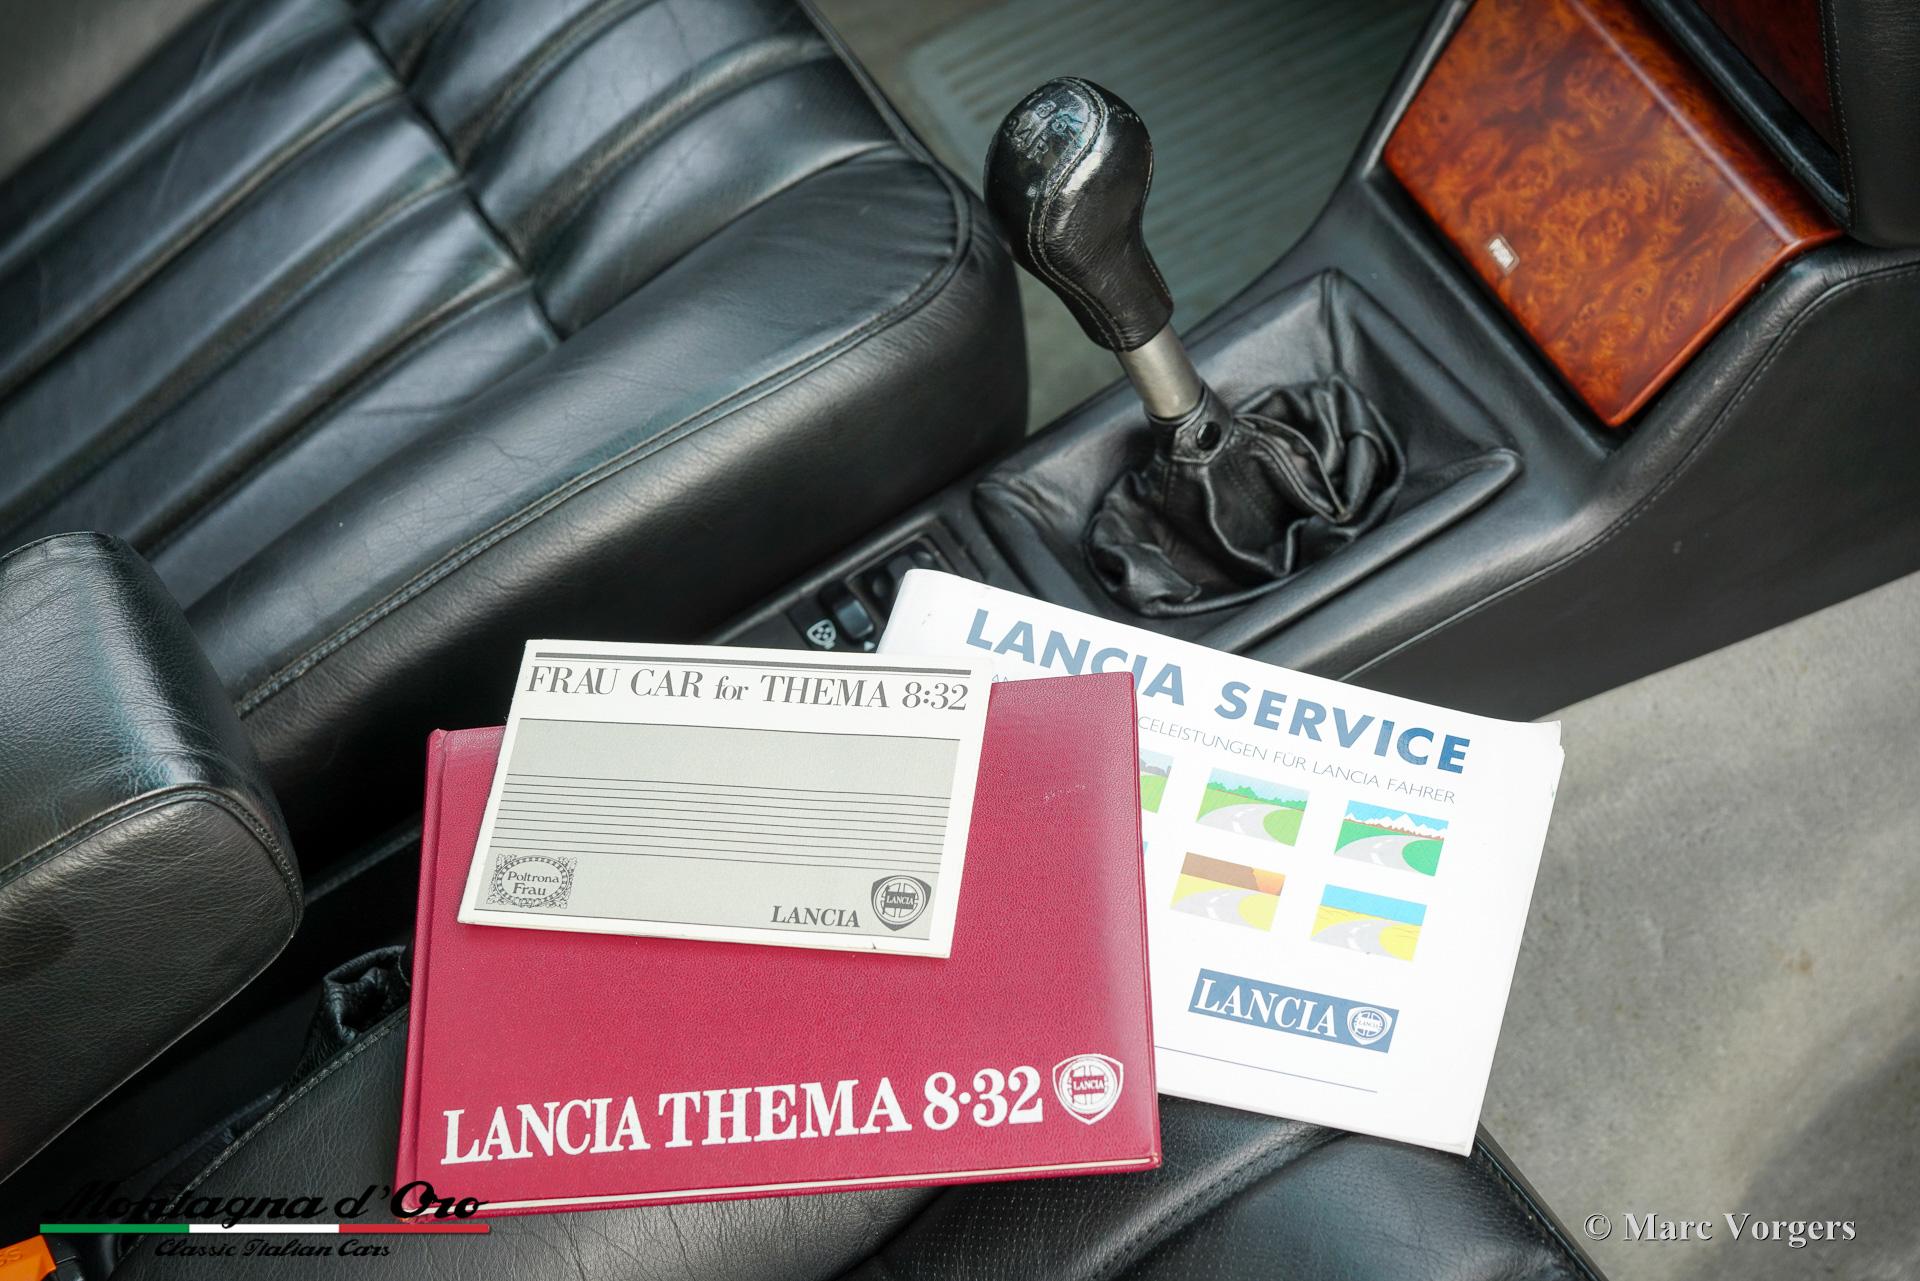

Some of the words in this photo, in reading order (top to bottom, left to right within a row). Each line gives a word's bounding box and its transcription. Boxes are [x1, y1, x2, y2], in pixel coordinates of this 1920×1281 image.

[526, 666, 618, 695] FRAU
[630, 669, 703, 698] CAR
[714, 676, 748, 700] for
[760, 674, 890, 708] THEMA
[902, 681, 968, 712] 8:32
[966, 608, 1184, 706] LANCIA
[1214, 680, 1471, 774] SERVICE
[1138, 715, 1267, 760] CELEISTUNGEN
[1273, 750, 1306, 770] FÜR
[1313, 761, 1380, 788] LANCIA
[1387, 778, 1455, 804] FAHRER
[507, 871, 559, 883] Poltrona
[512, 882, 547, 896] Frau
[770, 905, 861, 928] LANCIA
[886, 895, 914, 905] LANCIA
[1194, 978, 1338, 1038] LANCIA
[1073, 1078, 1104, 1092] LANCIA
[440, 1095, 651, 1165] LANCIA
[658, 1077, 912, 1148] THEMA
